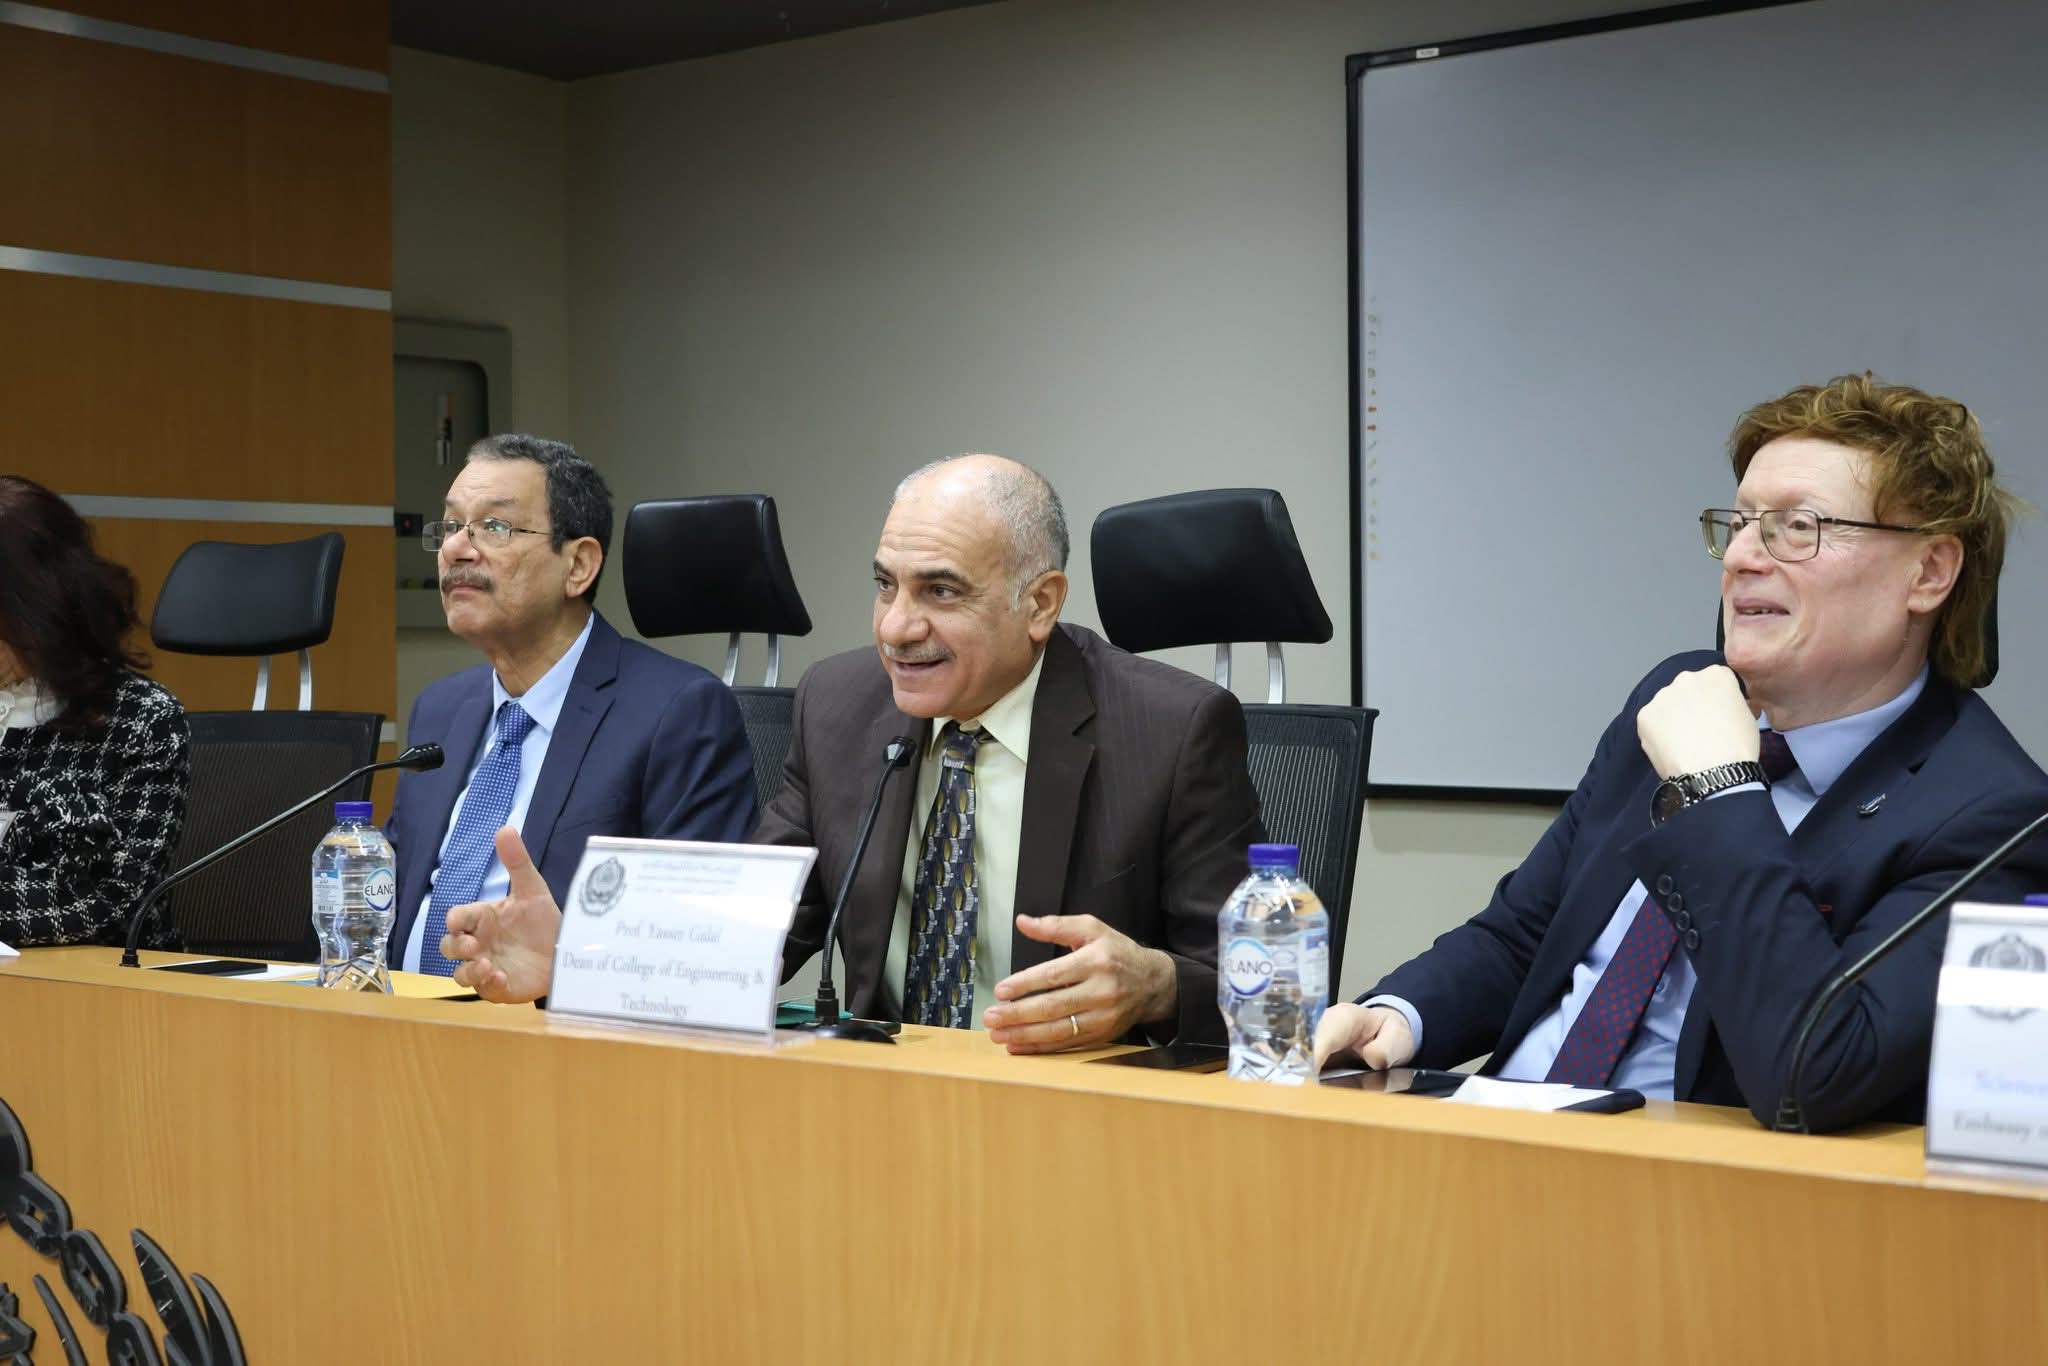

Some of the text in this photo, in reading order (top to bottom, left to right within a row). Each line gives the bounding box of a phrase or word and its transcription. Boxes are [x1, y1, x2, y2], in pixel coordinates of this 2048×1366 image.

[562, 951, 594, 969] Dean
[597, 954, 611, 971] of
[612, 955, 657, 982] College
[658, 960, 675, 976] of
[674, 959, 750, 991] Engineering
[620, 991, 689, 1018] Technology
